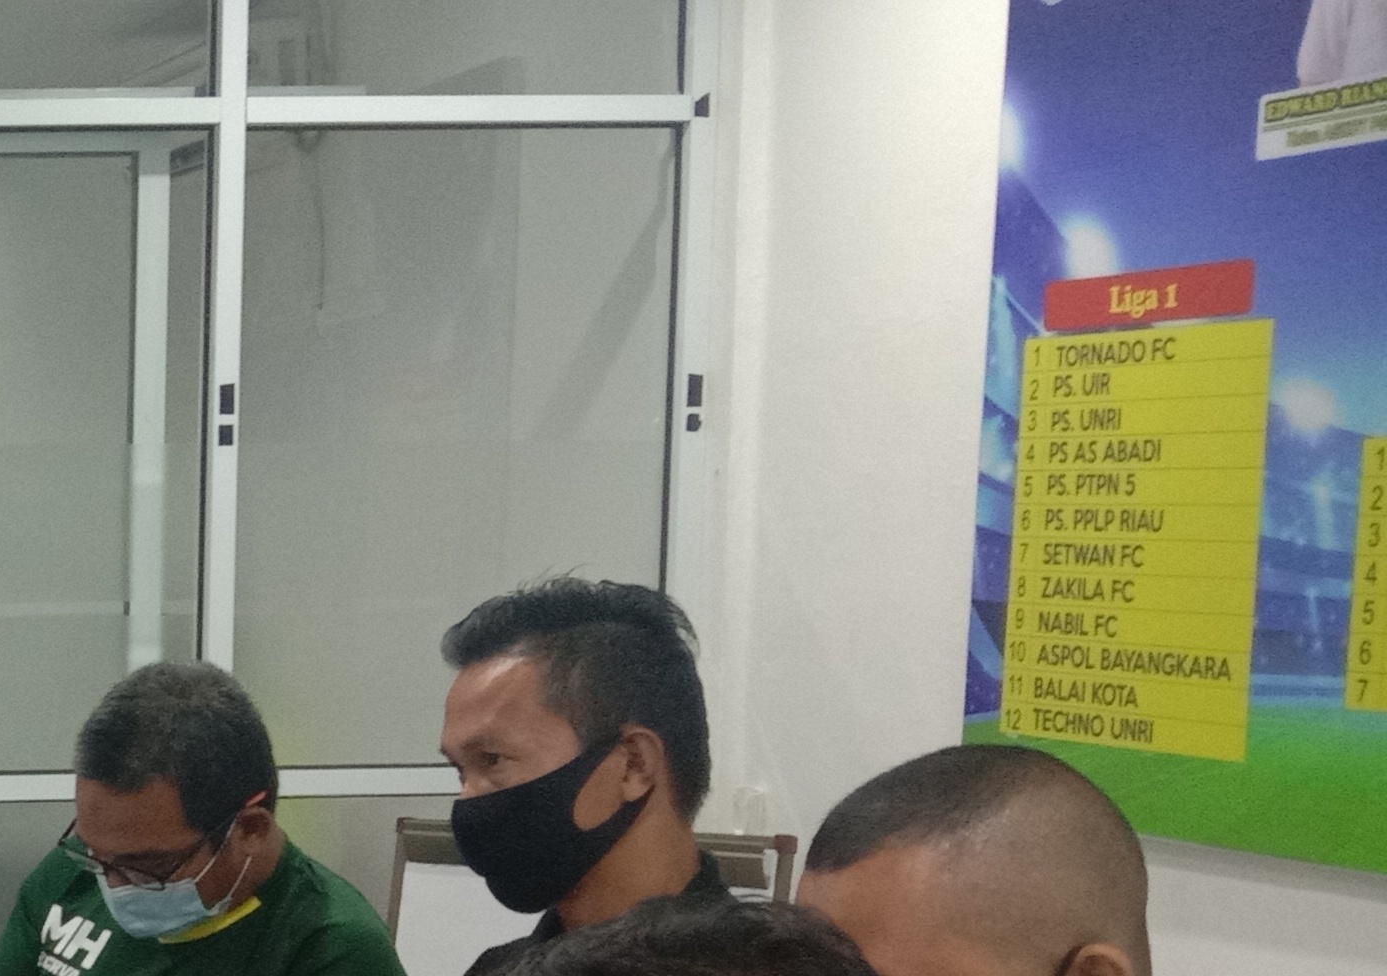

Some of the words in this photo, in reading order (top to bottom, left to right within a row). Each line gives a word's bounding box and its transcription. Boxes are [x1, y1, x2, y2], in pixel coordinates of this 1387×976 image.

[1109, 285, 1159, 318] Liga
[1165, 284, 1178, 308] 1
[1056, 340, 1146, 366] TORNADO
[1151, 337, 1176, 361] FC
[1029, 380, 1039, 400] 2
[1053, 375, 1075, 397] PS.
[1082, 373, 1111, 396] UIR
[1028, 410, 1037, 431] 3
[1051, 409, 1074, 432] PS.
[1080, 408, 1121, 430] UNRI
[1049, 441, 1068, 463] PS
[1073, 440, 1097, 463] AS
[1103, 439, 1162, 462] ABADI
[1376, 446, 1385, 471] 1
[1024, 475, 1033, 497] 5
[1047, 474, 1069, 496] PS.
[1076, 474, 1119, 496] PTPN
[1126, 474, 1136, 496] 5
[1370, 485, 1383, 511] 2
[1044, 509, 1068, 531] PS.
[1073, 509, 1115, 532] PPLP
[1120, 509, 1164, 532] RIAU
[1368, 523, 1381, 547] 3
[1019, 543, 1029, 562] 7
[1043, 543, 1115, 567] SETWAN
[1121, 545, 1144, 568] FC
[1364, 561, 1377, 585] 4
[1041, 577, 1104, 600] ZAKILA
[1111, 580, 1135, 603] FC
[1038, 611, 1088, 636] NABIL
[1094, 615, 1118, 638] FC
[1362, 600, 1375, 626] 5
[1009, 641, 1026, 663] 10
[1037, 644, 1094, 670] ASPOL
[1100, 648, 1231, 682] BAYANGKARA
[1359, 639, 1372, 665] 6
[1009, 675, 1023, 696] 11
[1034, 677, 1086, 701] BALAI
[1091, 682, 1138, 708] KOTA
[1357, 679, 1368, 703] 7
[1005, 709, 1022, 731] 12
[1033, 708, 1105, 737] TECHNO
[1110, 717, 1154, 743] UNRI
[41, 903, 112, 970] MH
